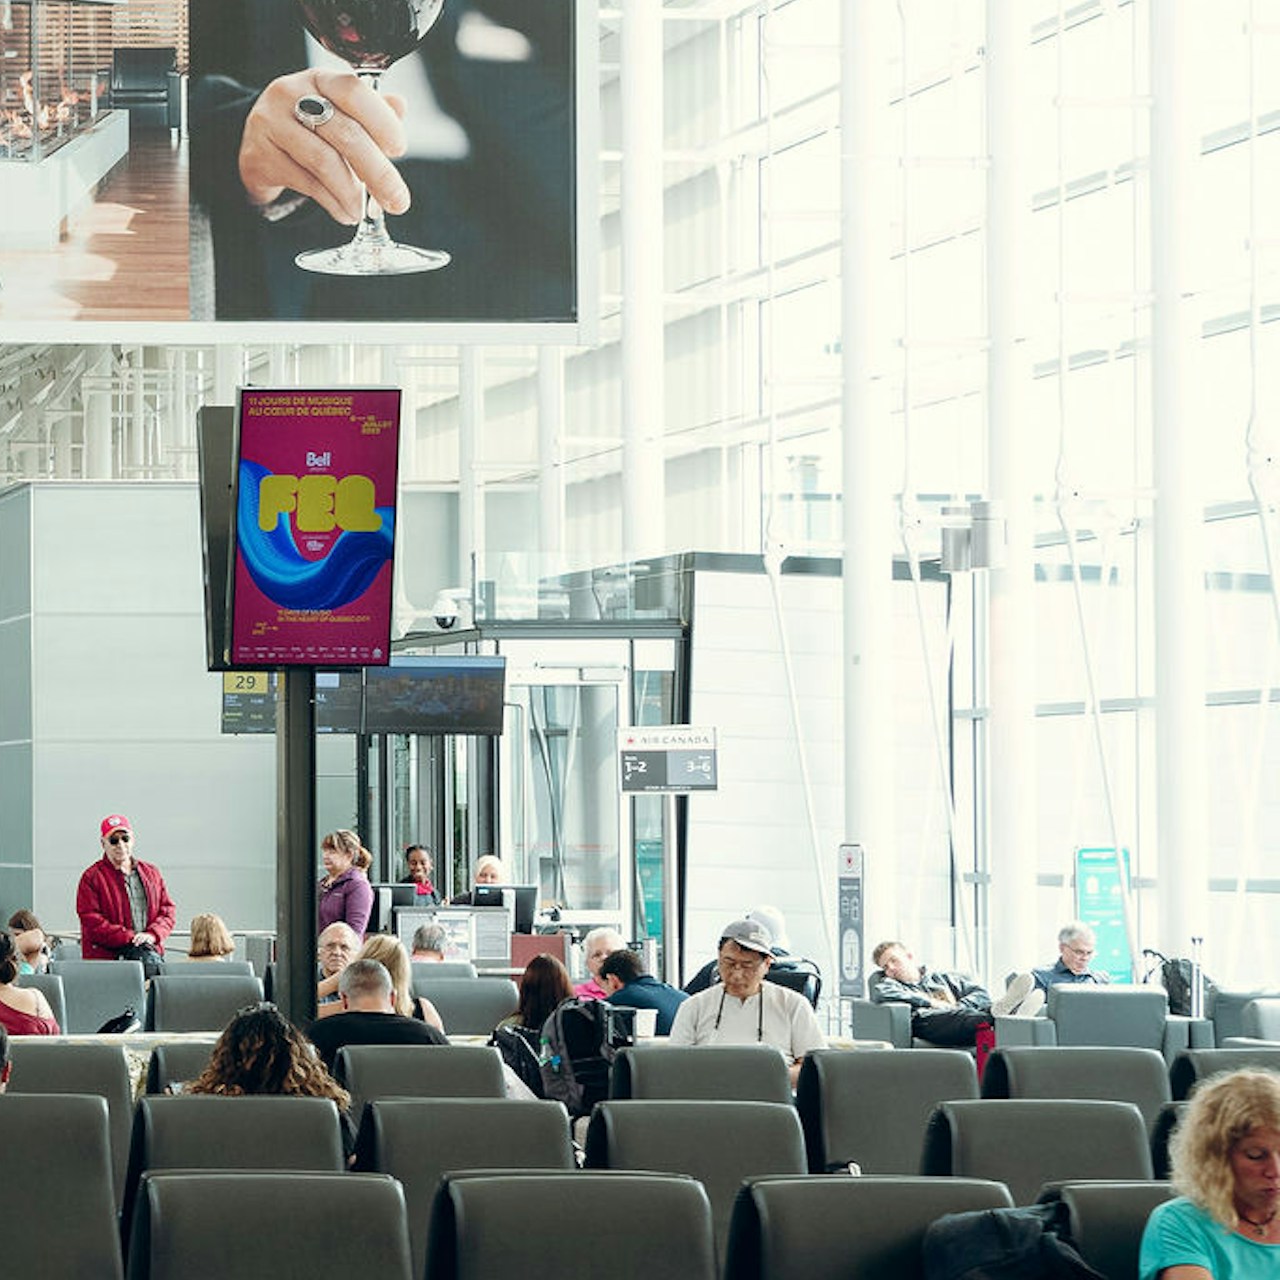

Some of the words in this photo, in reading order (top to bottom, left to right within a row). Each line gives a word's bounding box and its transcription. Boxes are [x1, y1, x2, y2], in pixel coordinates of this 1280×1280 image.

[258, 397, 292, 406] JOURS
[293, 397, 306, 406] DE
[308, 396, 354, 406] MUSIQUE
[297, 407, 310, 416] DE
[306, 451, 331, 467] Bell
[258, 474, 383, 533] FEQ
[235, 675, 257, 690] 29
[662, 735, 710, 744] CANADA
